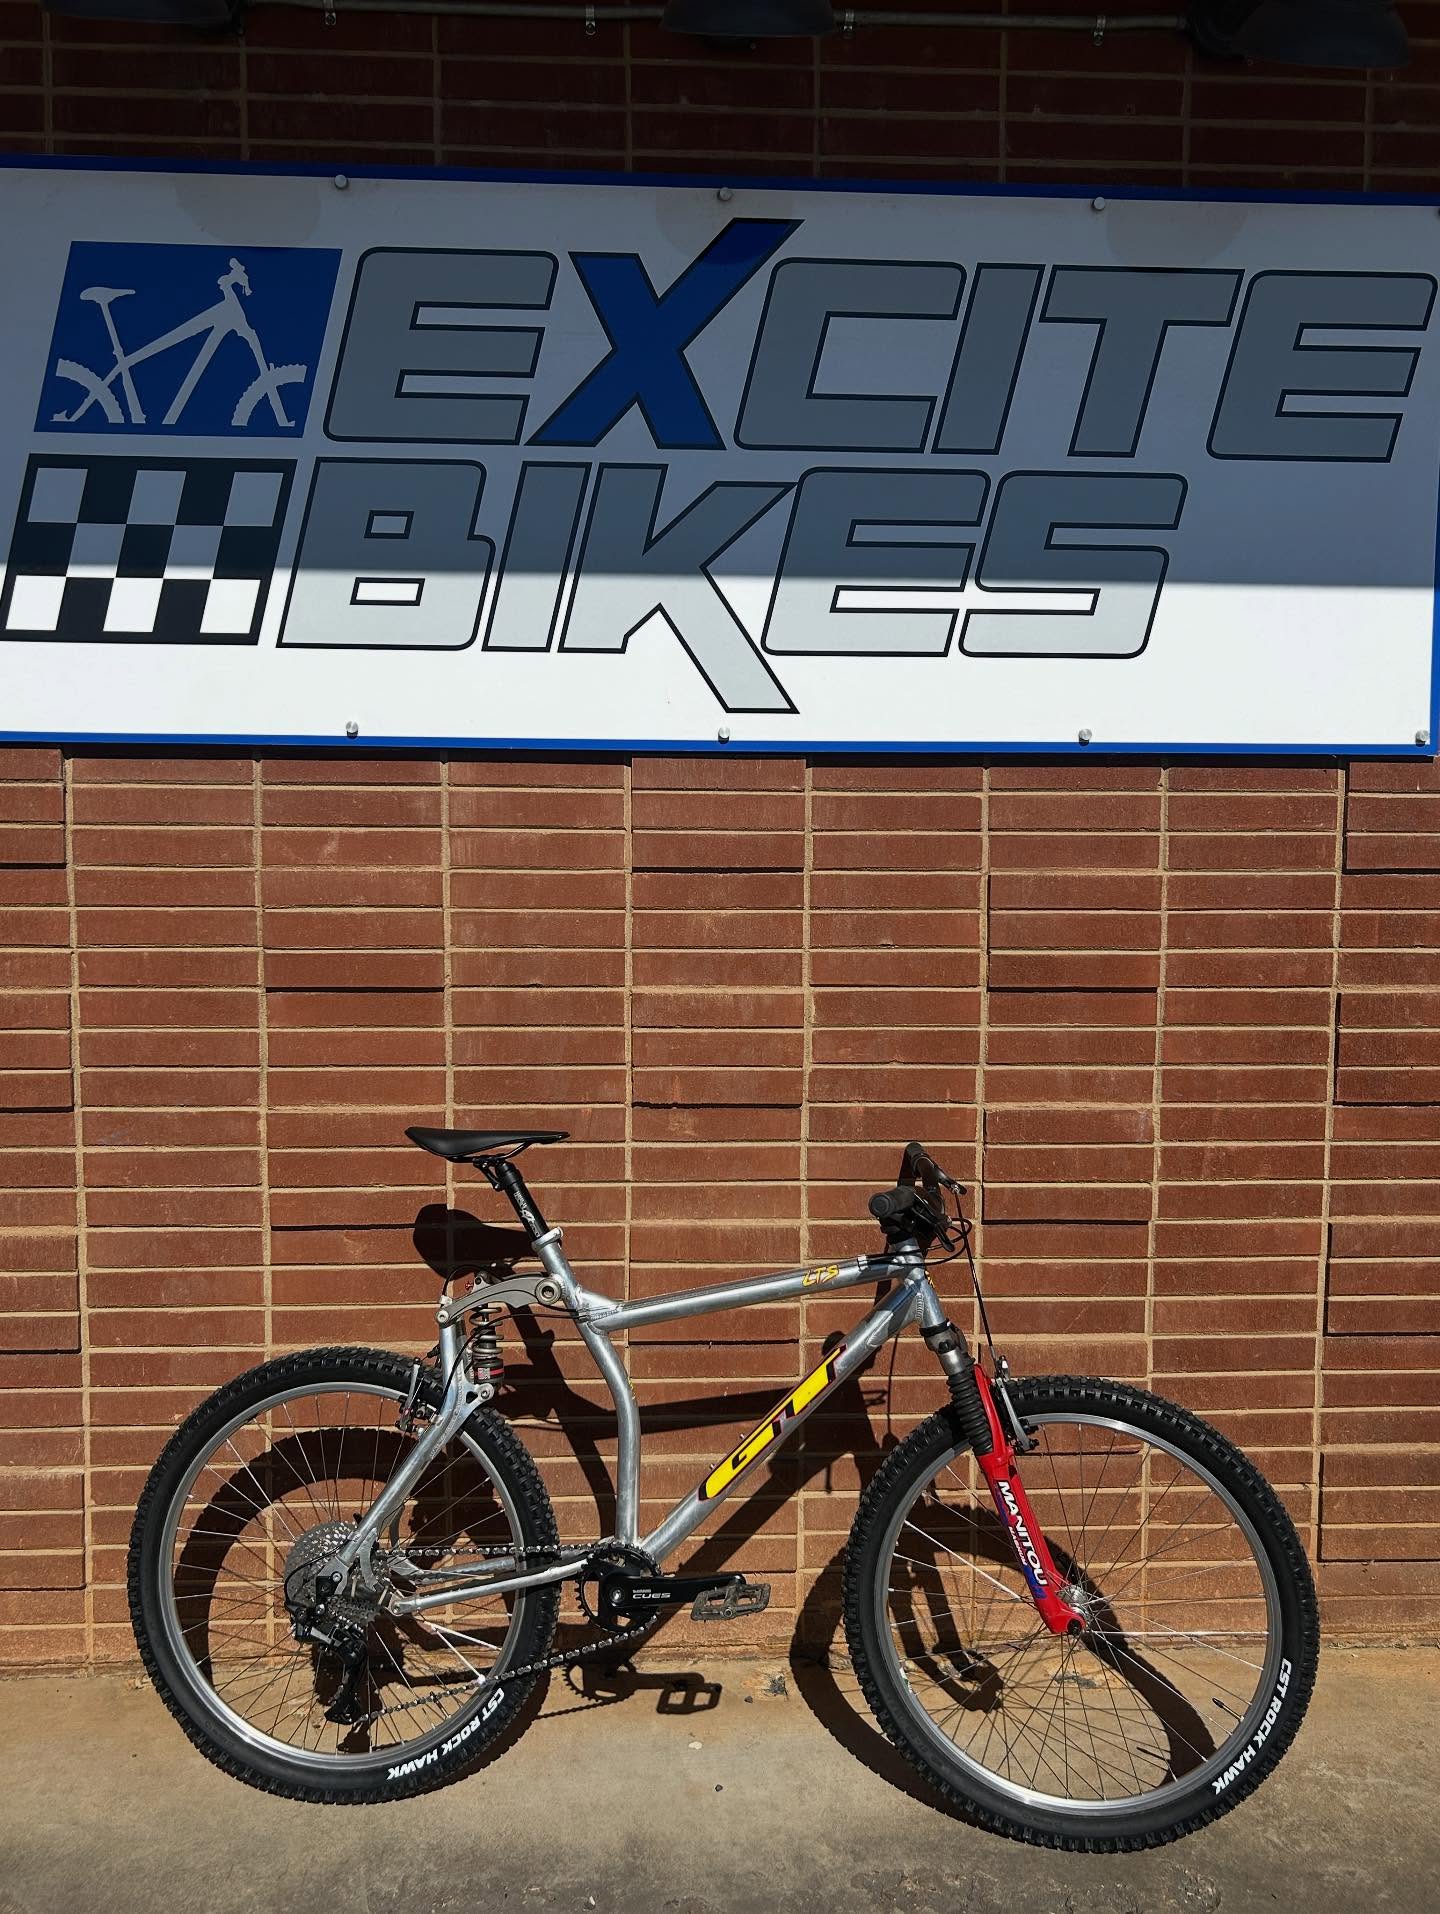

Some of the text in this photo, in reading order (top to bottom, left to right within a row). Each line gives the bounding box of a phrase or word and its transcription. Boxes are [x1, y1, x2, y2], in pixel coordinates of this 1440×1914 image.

[323, 217, 1438, 463] EXCITE
[276, 456, 1188, 714] BIKES
[802, 1263, 840, 1287] LTS
[698, 1344, 847, 1501] GT
[998, 1481, 1049, 1587] MANITOU
[632, 1592, 671, 1600] CUES
[386, 1687, 505, 1780] CST ROCK HAWK
[1211, 1657, 1292, 1796] CST ROCK HAWK
